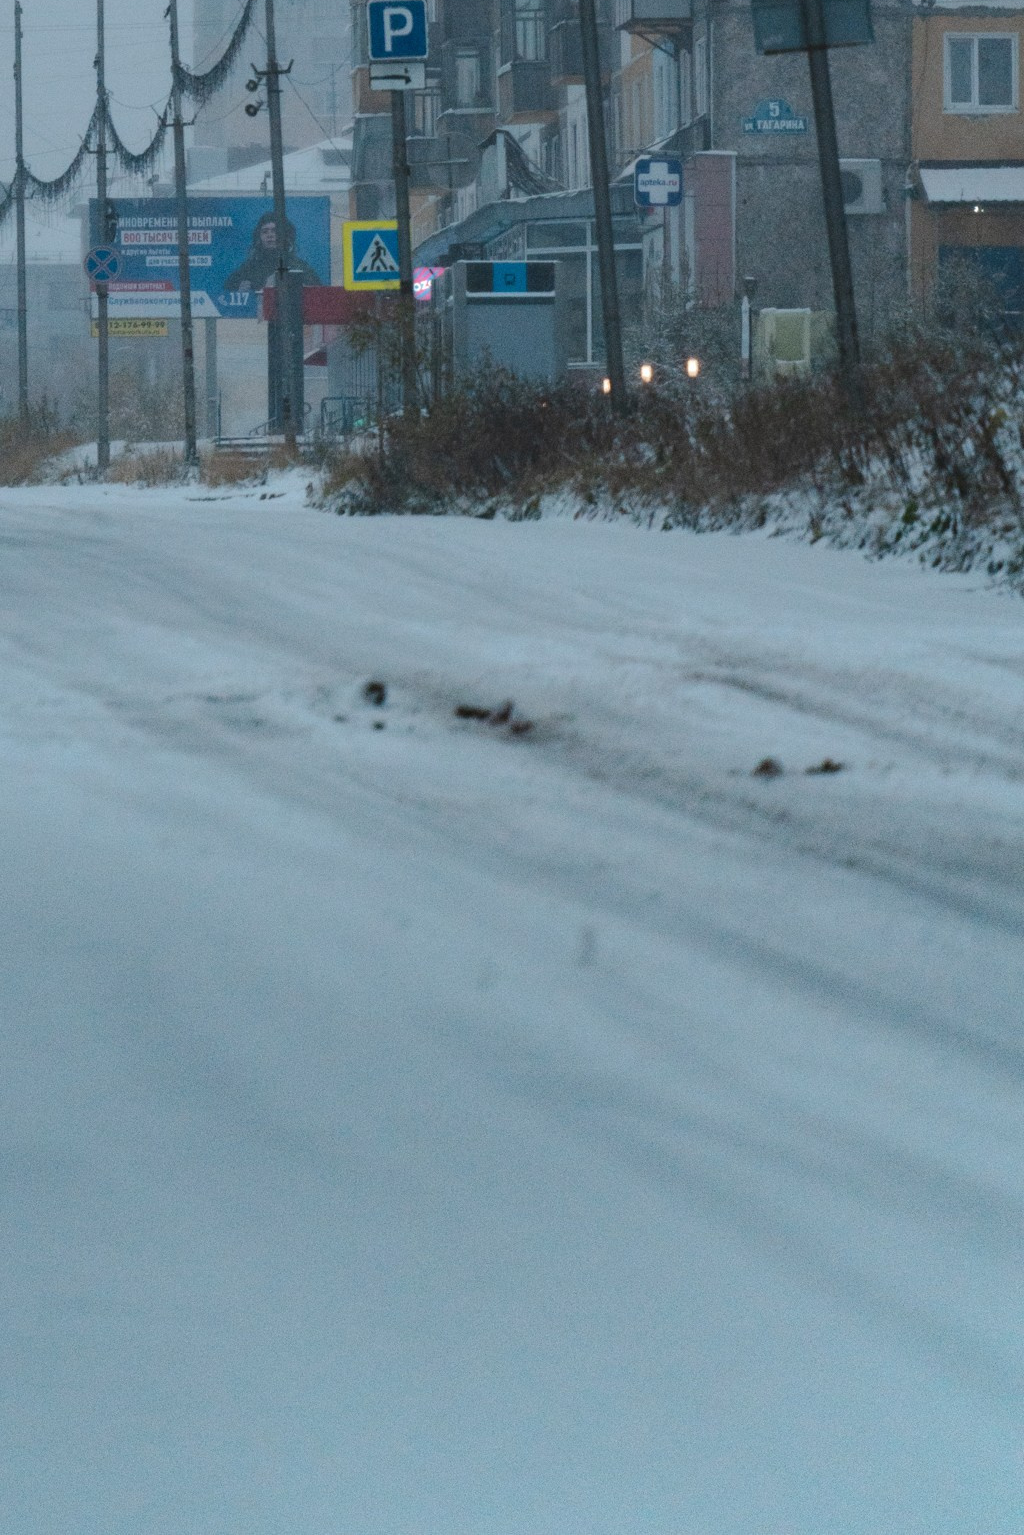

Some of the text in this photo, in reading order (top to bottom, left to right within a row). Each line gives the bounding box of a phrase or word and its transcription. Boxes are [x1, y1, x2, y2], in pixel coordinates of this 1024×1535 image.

[383, 7, 413, 52] P
[769, 101, 780, 117] 5
[756, 119, 805, 130] ГАГАРИНА
[639, 178, 678, 187] apteka.ru
[192, 216, 233, 227] ВЫПЛАТА
[142, 232, 173, 243] ТЫСЯЧ
[175, 230, 209, 243] РБЛЕЙ
[229, 292, 250, 305] 117
